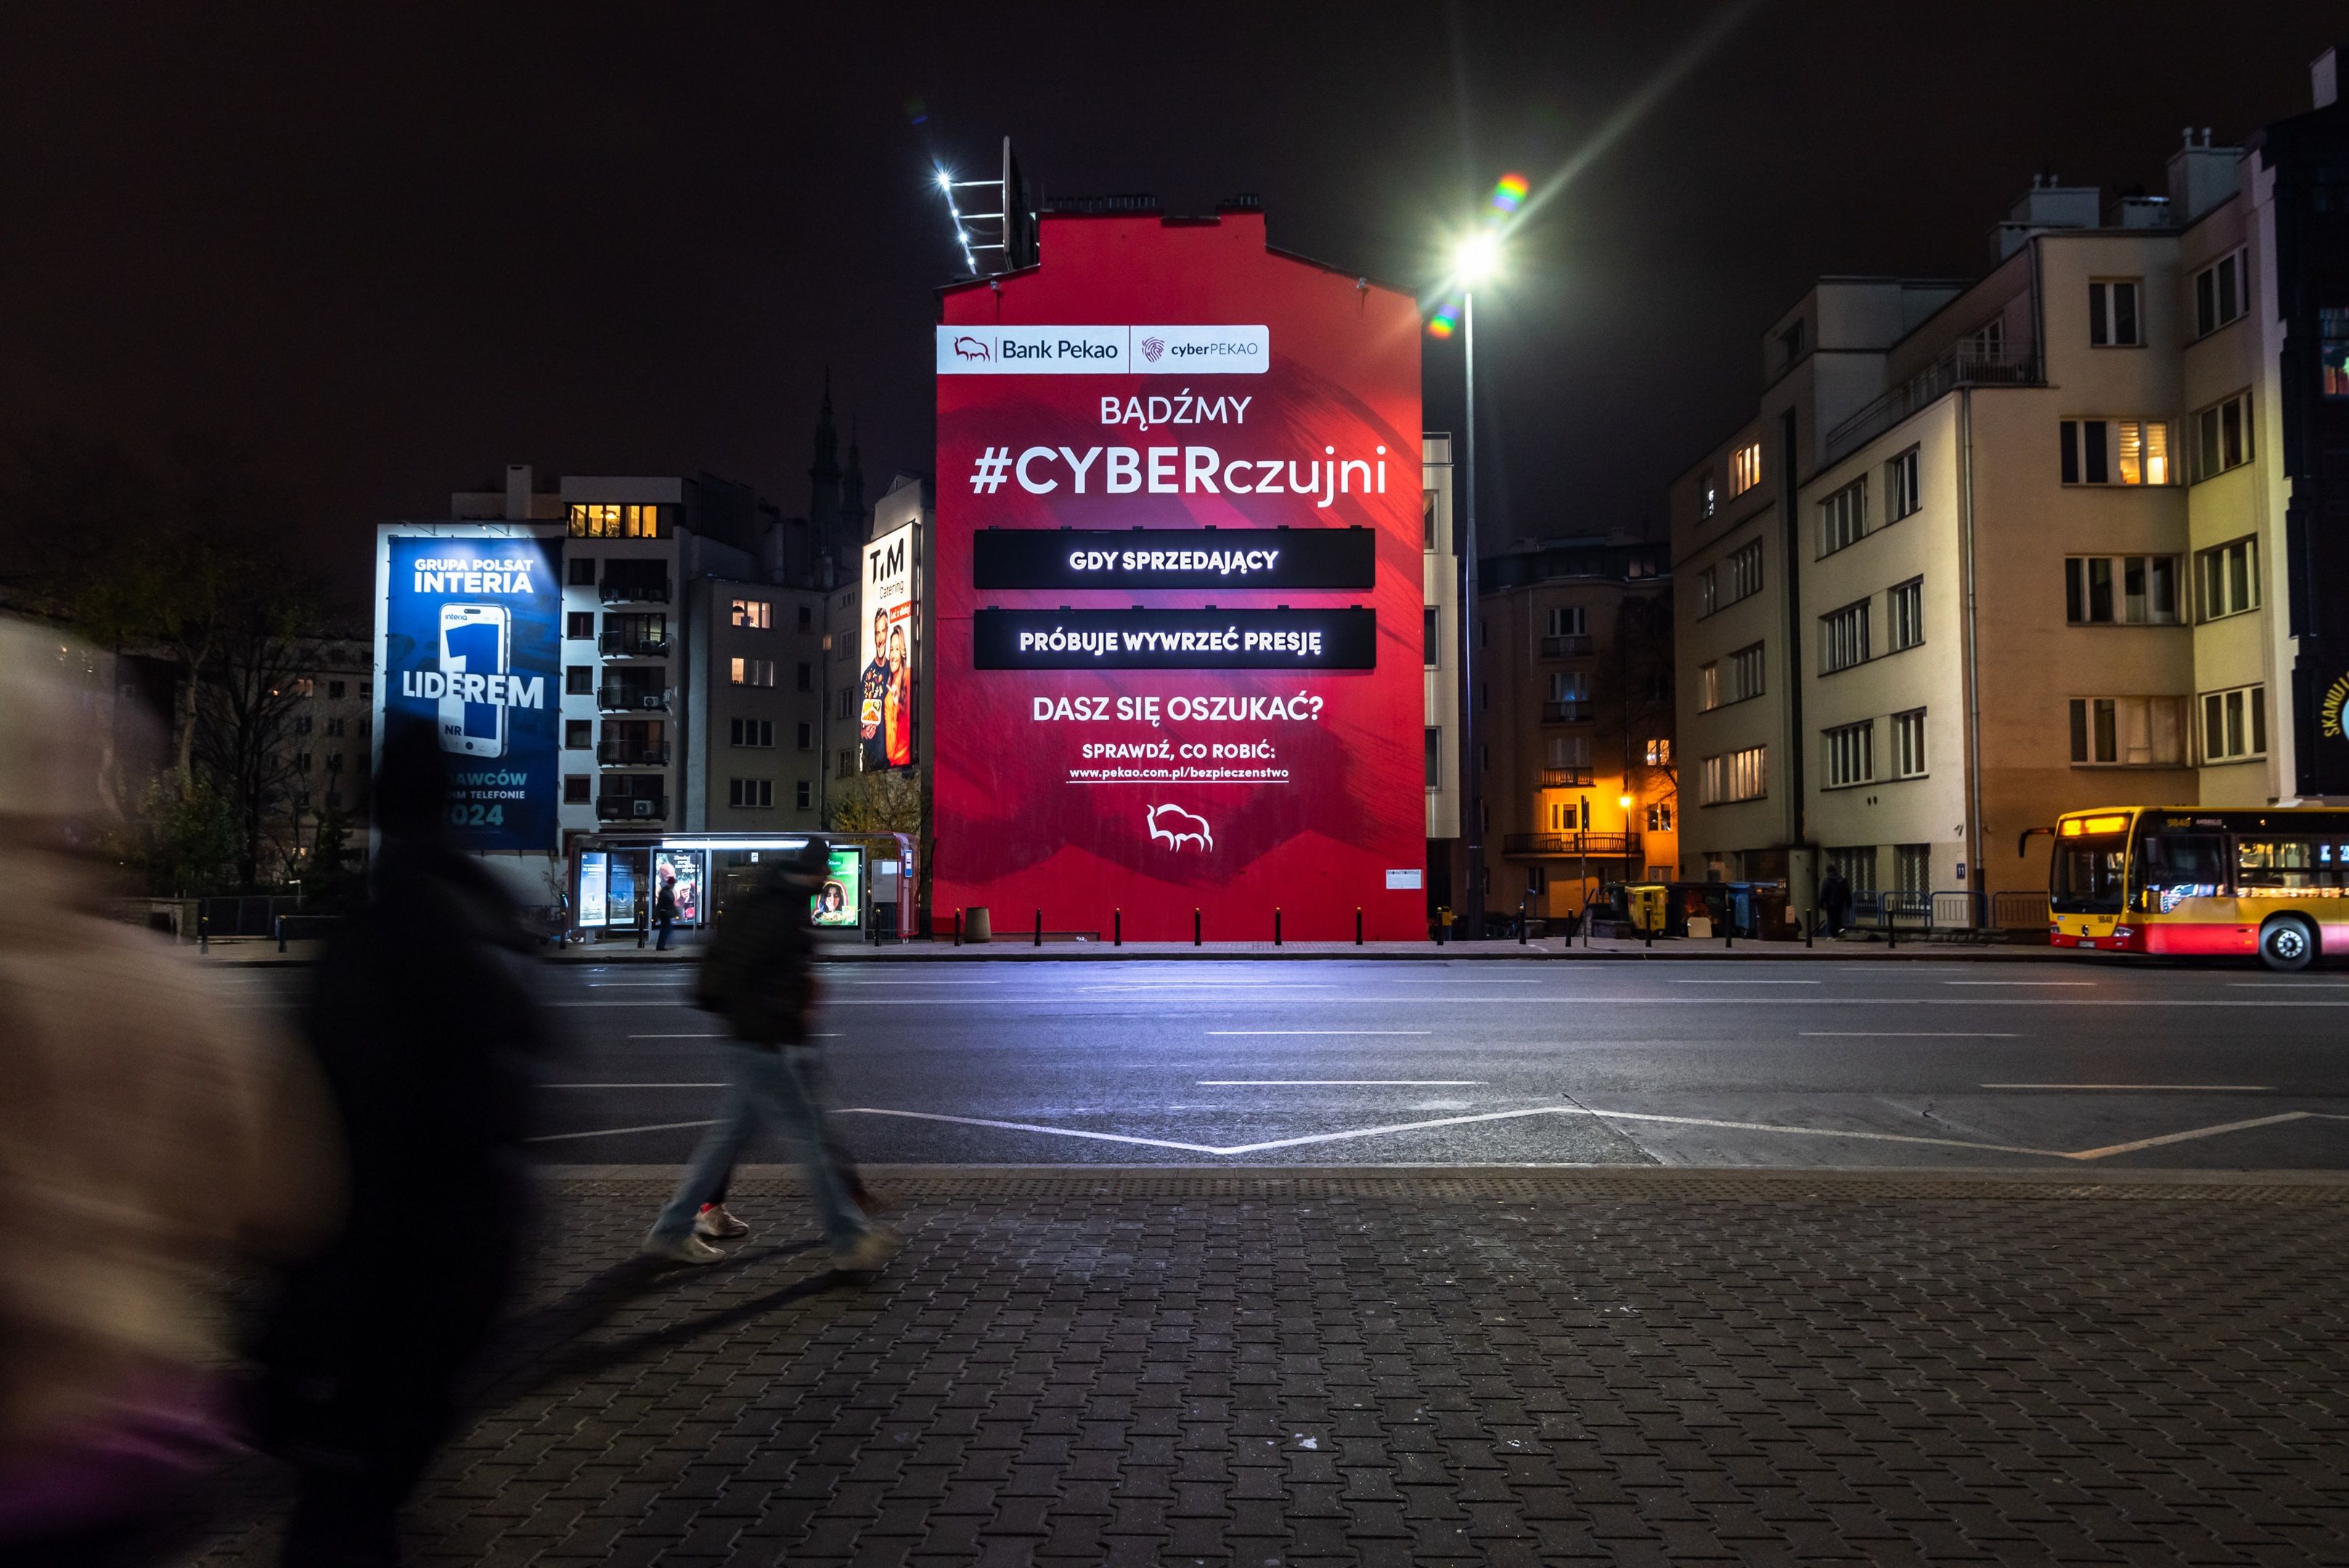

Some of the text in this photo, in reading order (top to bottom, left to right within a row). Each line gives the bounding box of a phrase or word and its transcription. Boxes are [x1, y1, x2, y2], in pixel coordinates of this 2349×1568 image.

[1002, 339, 1119, 359] Bank Pekao
[1171, 342, 1258, 356] cyberPEKAO
[1101, 388, 1252, 432] BĄDŹMY
[969, 445, 1386, 508] #CYBERczujni
[414, 558, 534, 572] GRUPA POLSAT
[1069, 550, 1278, 574] GDY SPRZEDAJĄCY
[414, 572, 534, 593] INTERIA
[879, 580, 904, 600] Catering
[1020, 626, 1322, 656] PRÓBUJE WYWRZEĆ PRESJĘ
[402, 670, 544, 710] LIDEREM
[1033, 690, 1323, 727] DASZ SIĘ OSZUKAĆ?
[445, 724, 462, 736] NR
[1082, 739, 1275, 761] SPRAWDŹ, CO ROBIĆ:
[1069, 767, 1289, 780] www.pekao.com.pl/bezpieczenstwo
[470, 791, 526, 799] TELEFONIE
[449, 804, 504, 826] 024
